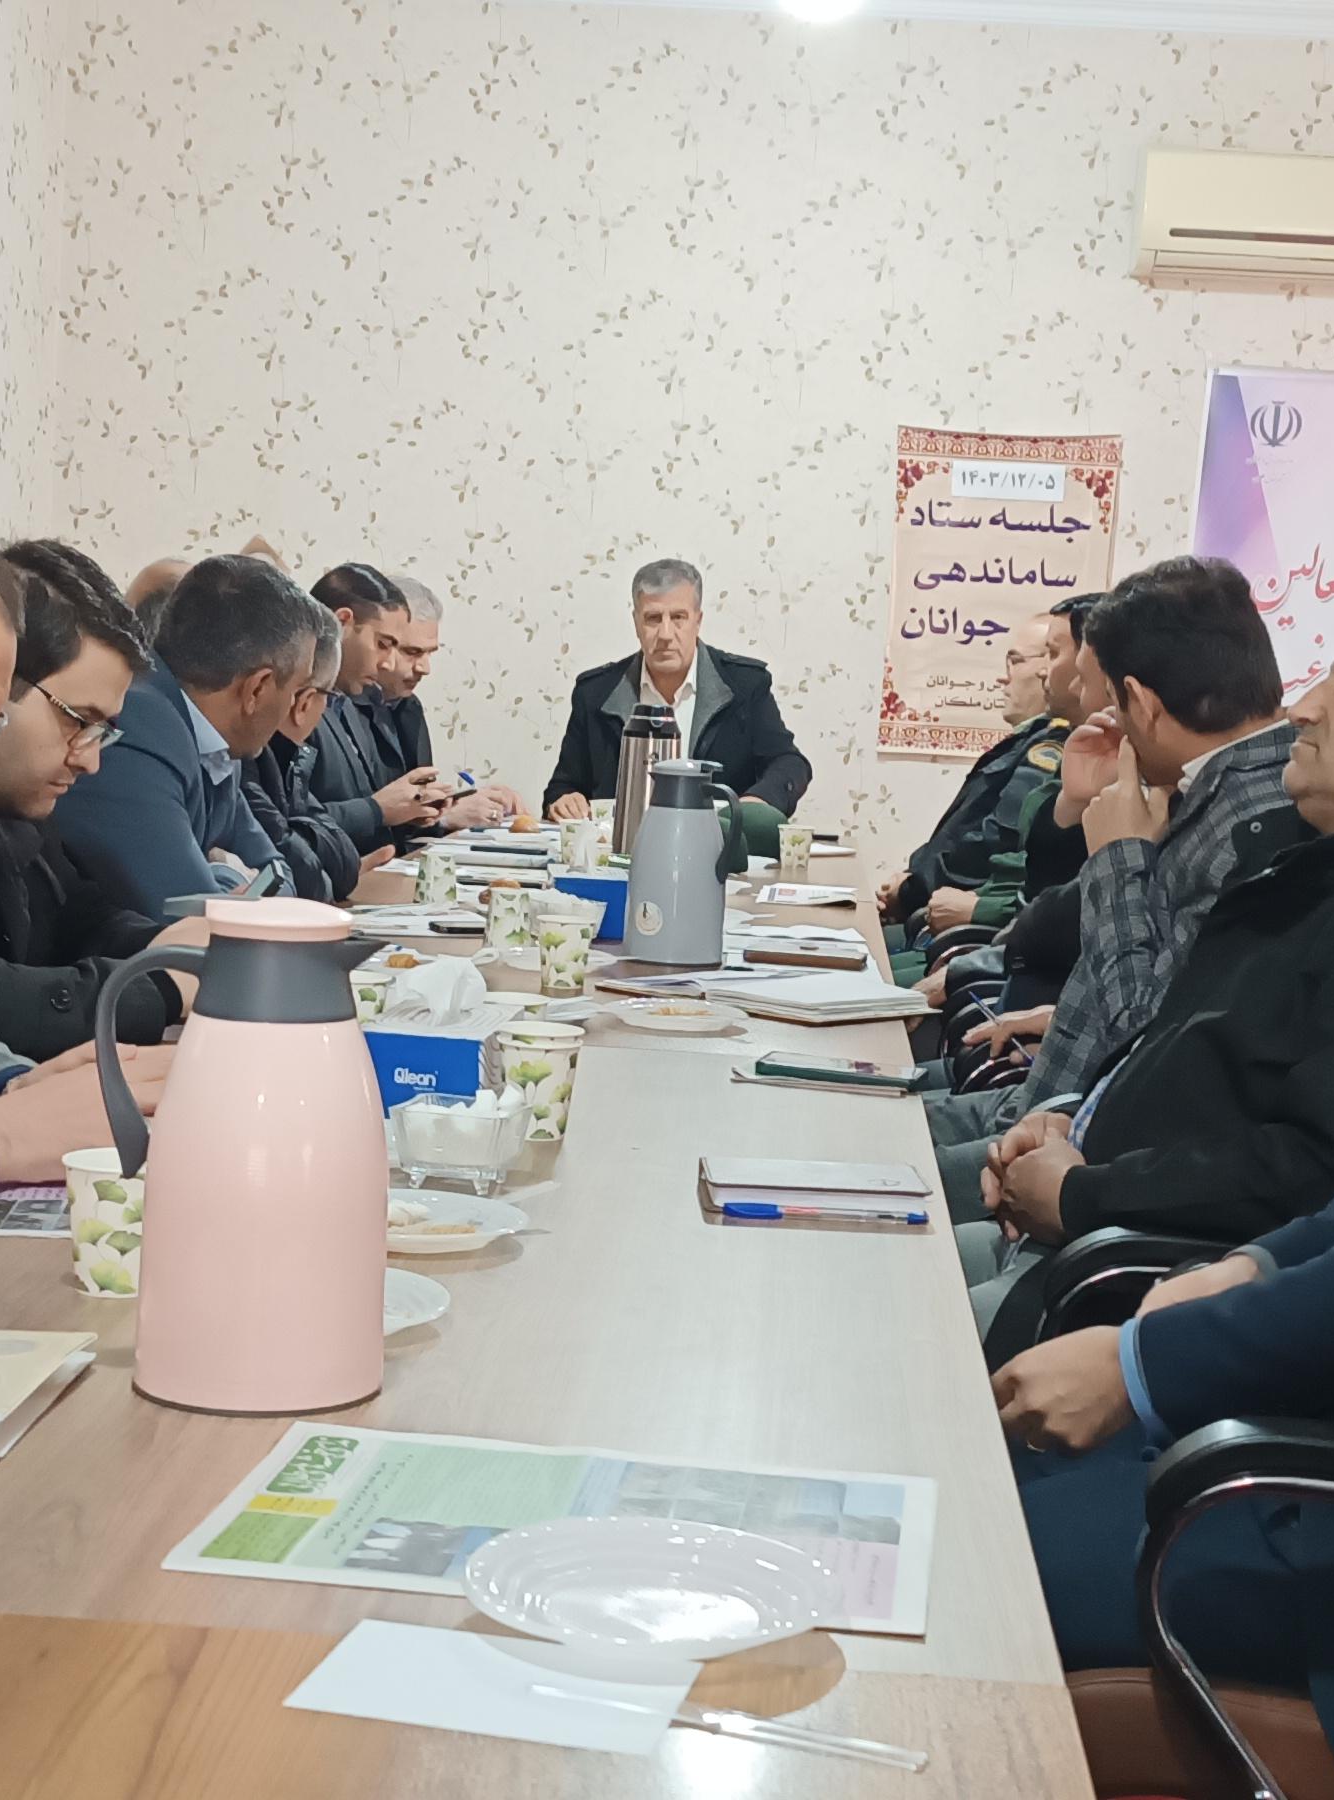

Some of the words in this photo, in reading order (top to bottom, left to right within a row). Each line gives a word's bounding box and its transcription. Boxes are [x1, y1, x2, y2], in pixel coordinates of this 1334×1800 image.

[960, 470, 1056, 490] ۱۴۰۳/۱۲/۰۵
[910, 498, 982, 529] ستاد
[988, 504, 1091, 543] جلسه
[913, 556, 1077, 591] ساماندهی
[900, 605, 1011, 646] جوانان
[934, 695, 981, 709] ملکان
[394, 1067, 437, 1087] Qlean
